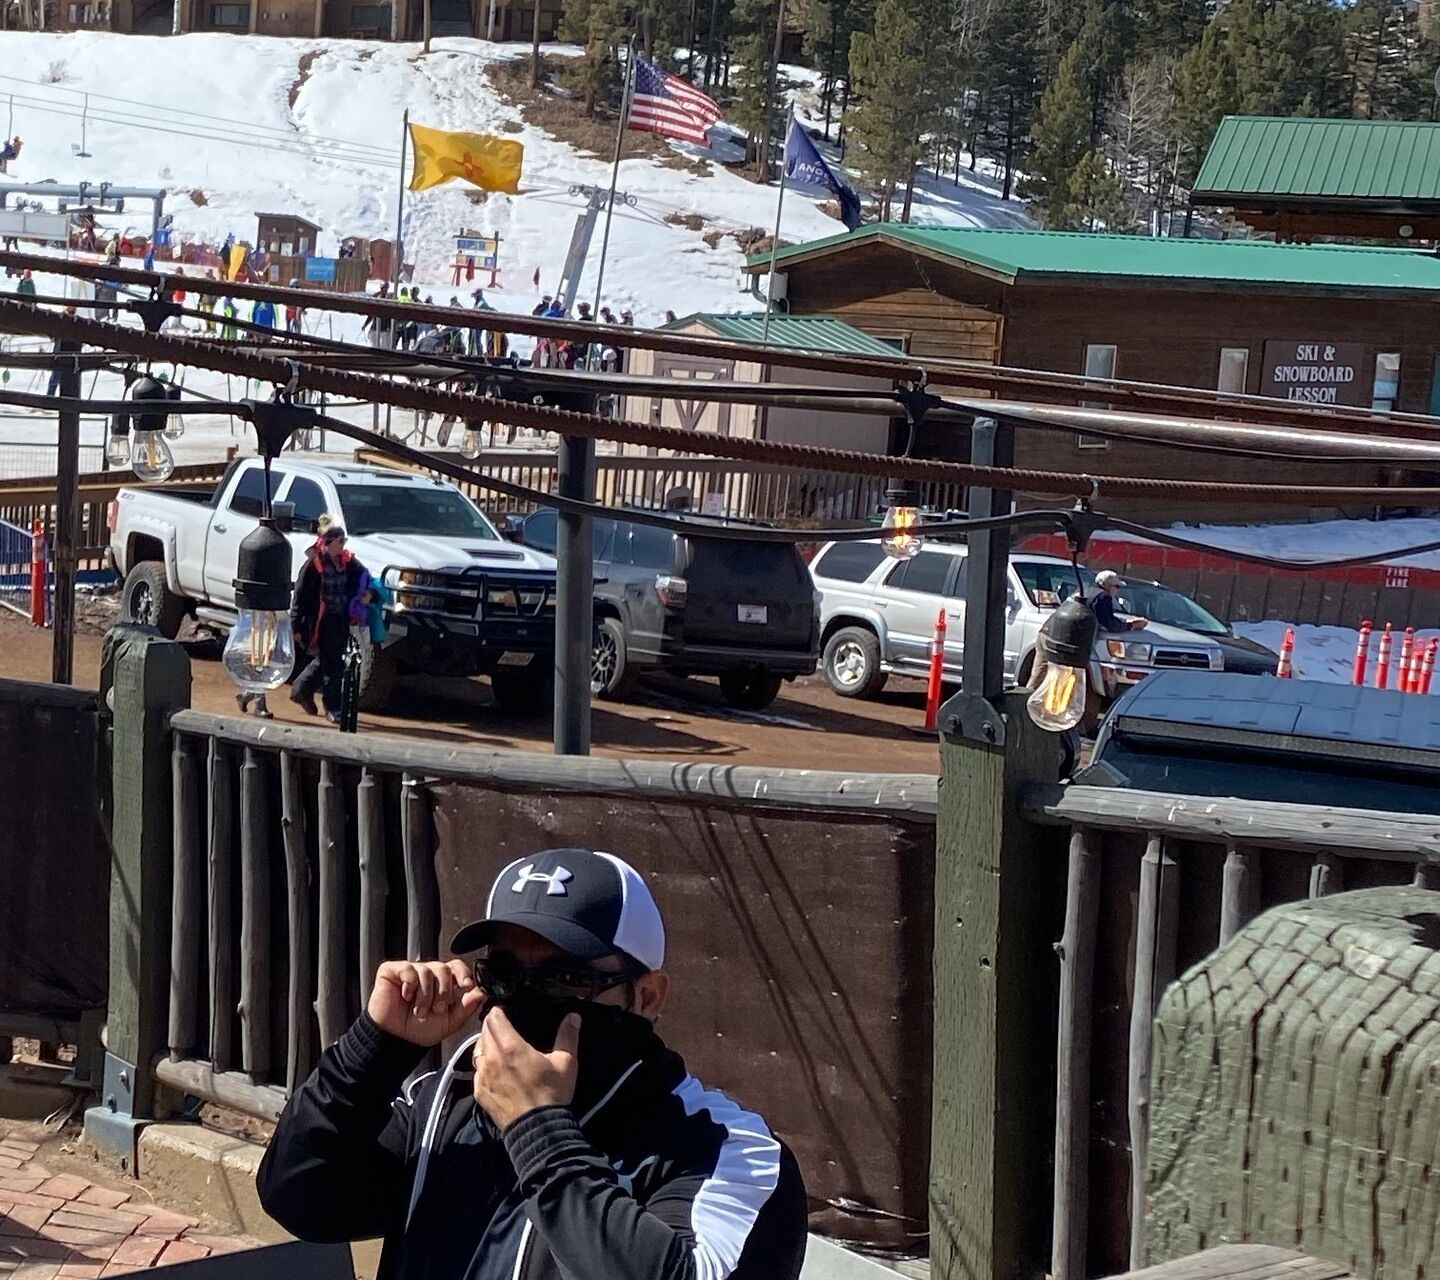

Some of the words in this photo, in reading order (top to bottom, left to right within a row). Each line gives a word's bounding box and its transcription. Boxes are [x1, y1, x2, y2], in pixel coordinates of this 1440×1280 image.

[1296, 345, 1319, 361] SKI
[1323, 345, 1336, 362] &
[1273, 366, 1355, 382] SNOWBOARD
[1288, 387, 1337, 403] LESSON
